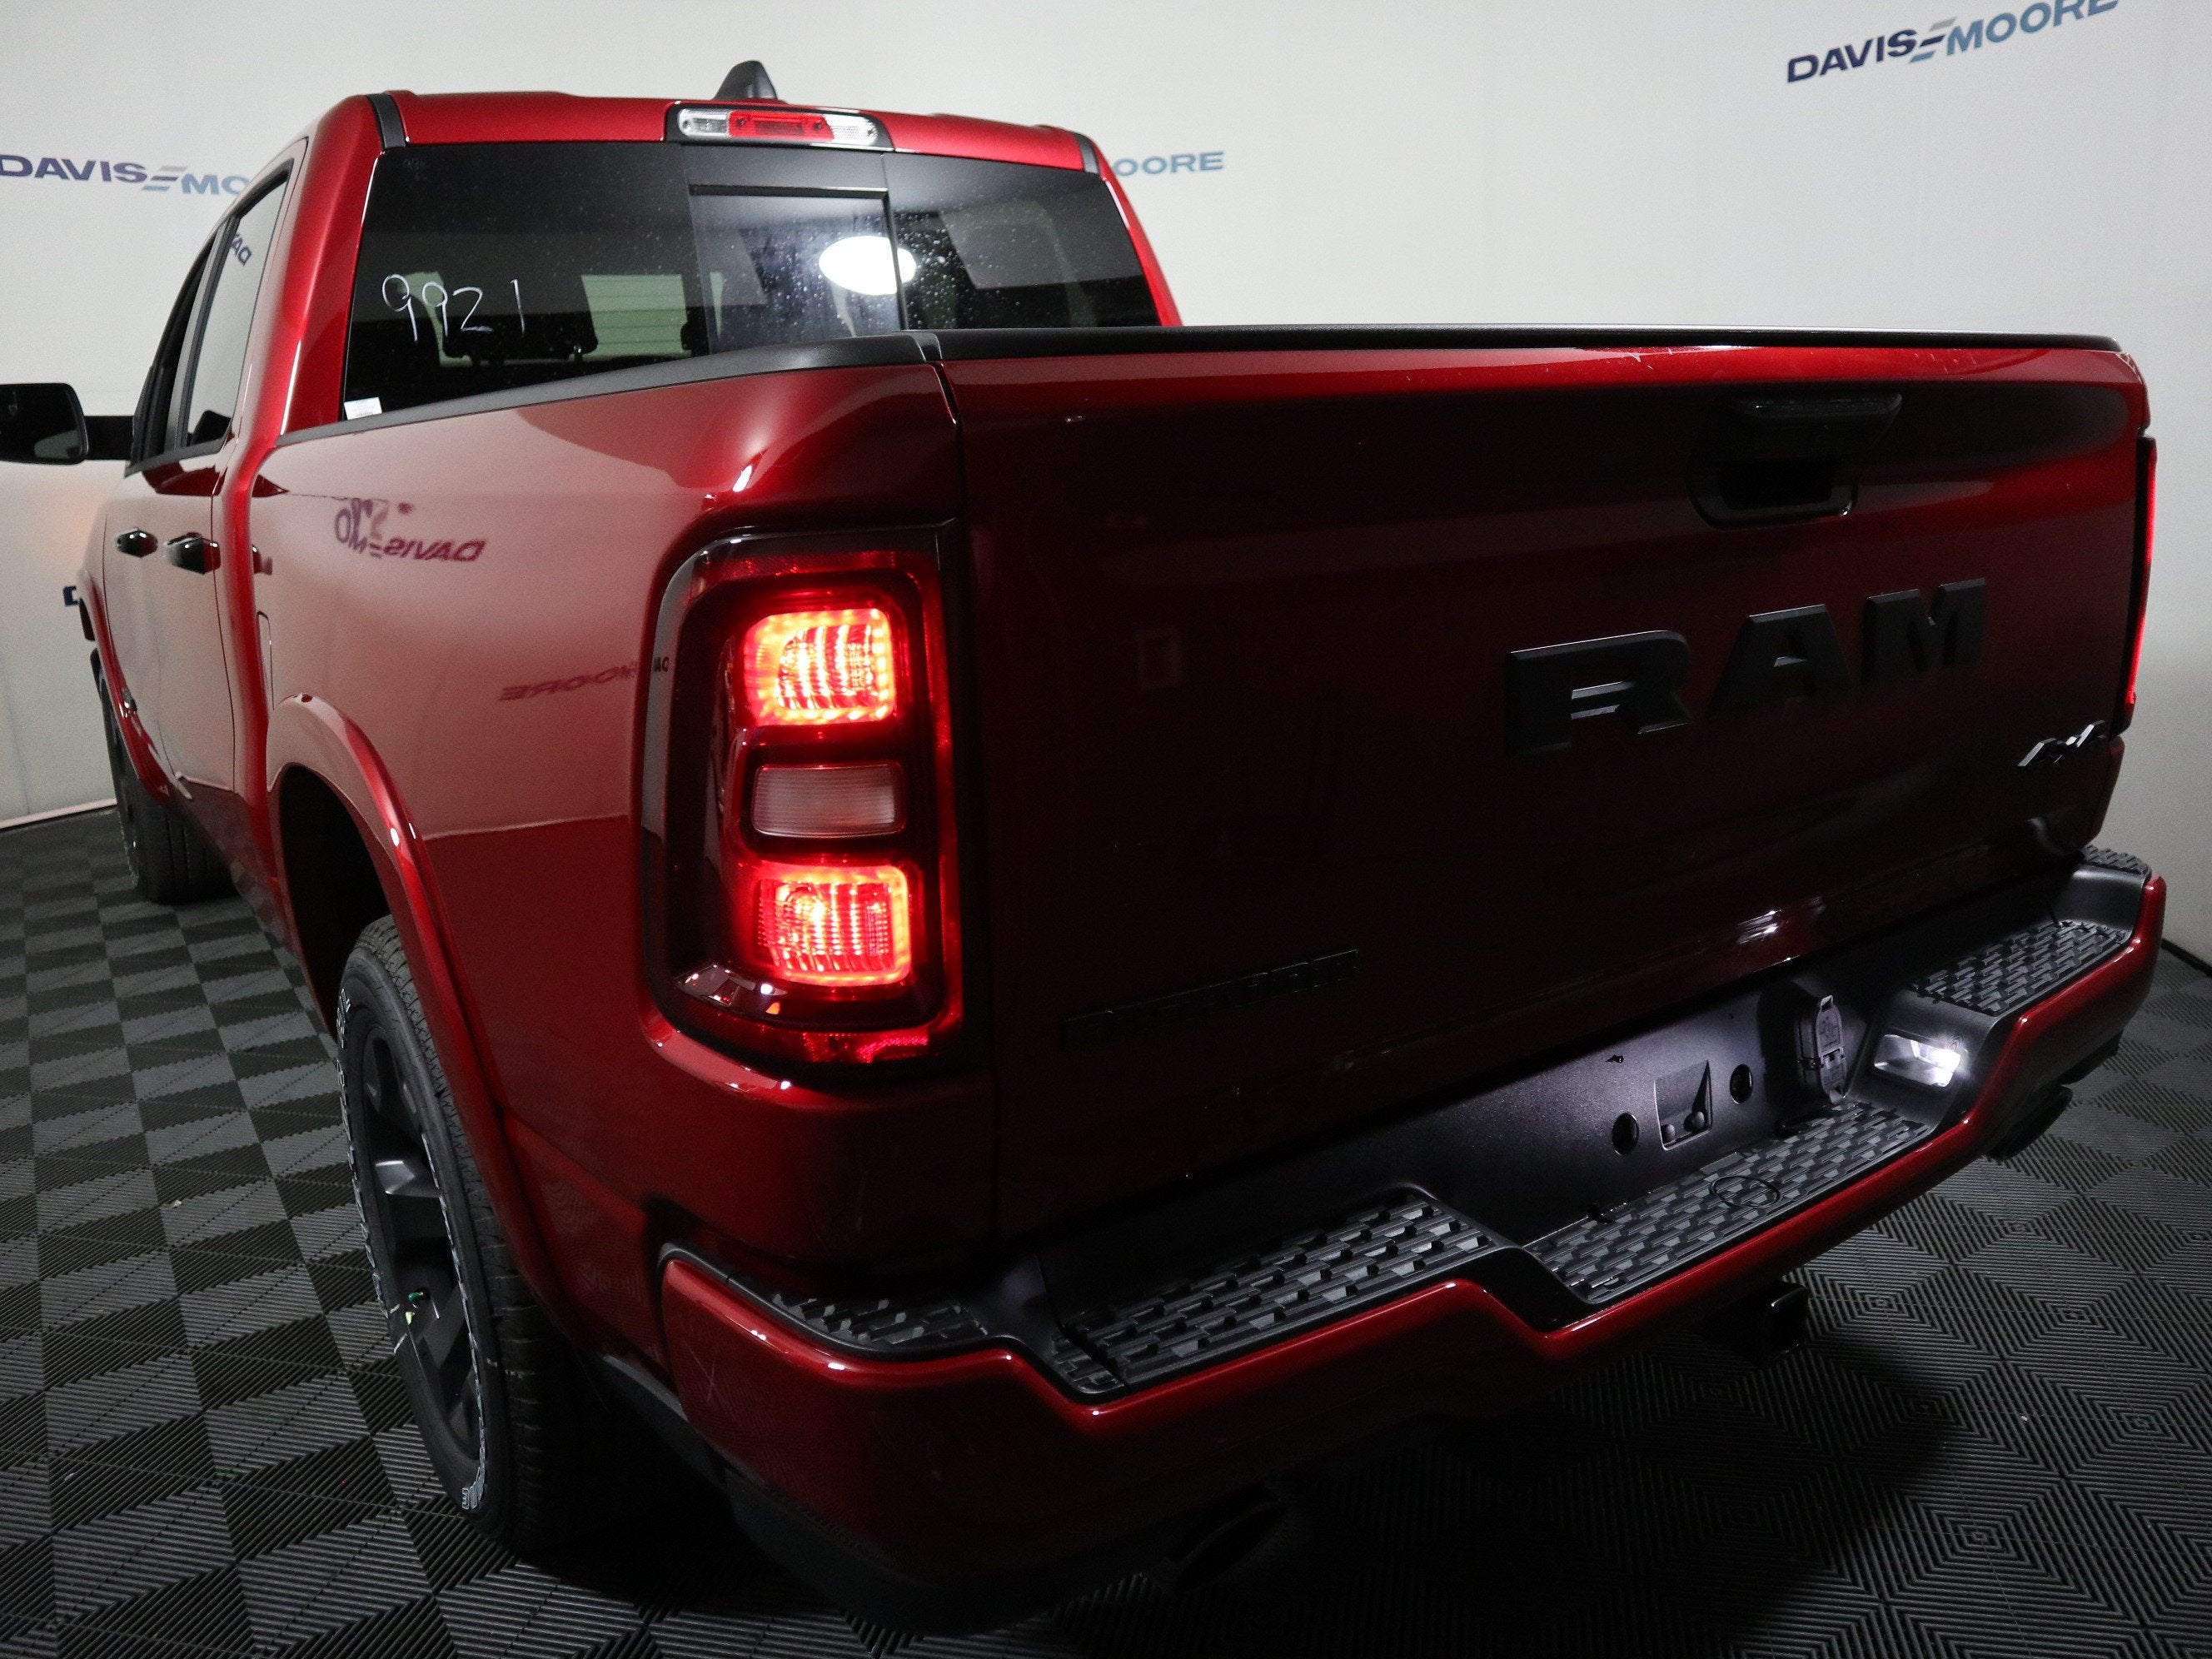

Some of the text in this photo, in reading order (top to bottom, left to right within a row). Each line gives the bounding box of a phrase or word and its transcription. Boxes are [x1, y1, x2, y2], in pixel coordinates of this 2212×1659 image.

[1787, 28, 1917, 83] DAVIS
[0, 154, 251, 195] DAVIS MO
[1113, 151, 1225, 177] OORE
[381, 273, 525, 342] 9921
[1506, 577, 1985, 756] RAM
